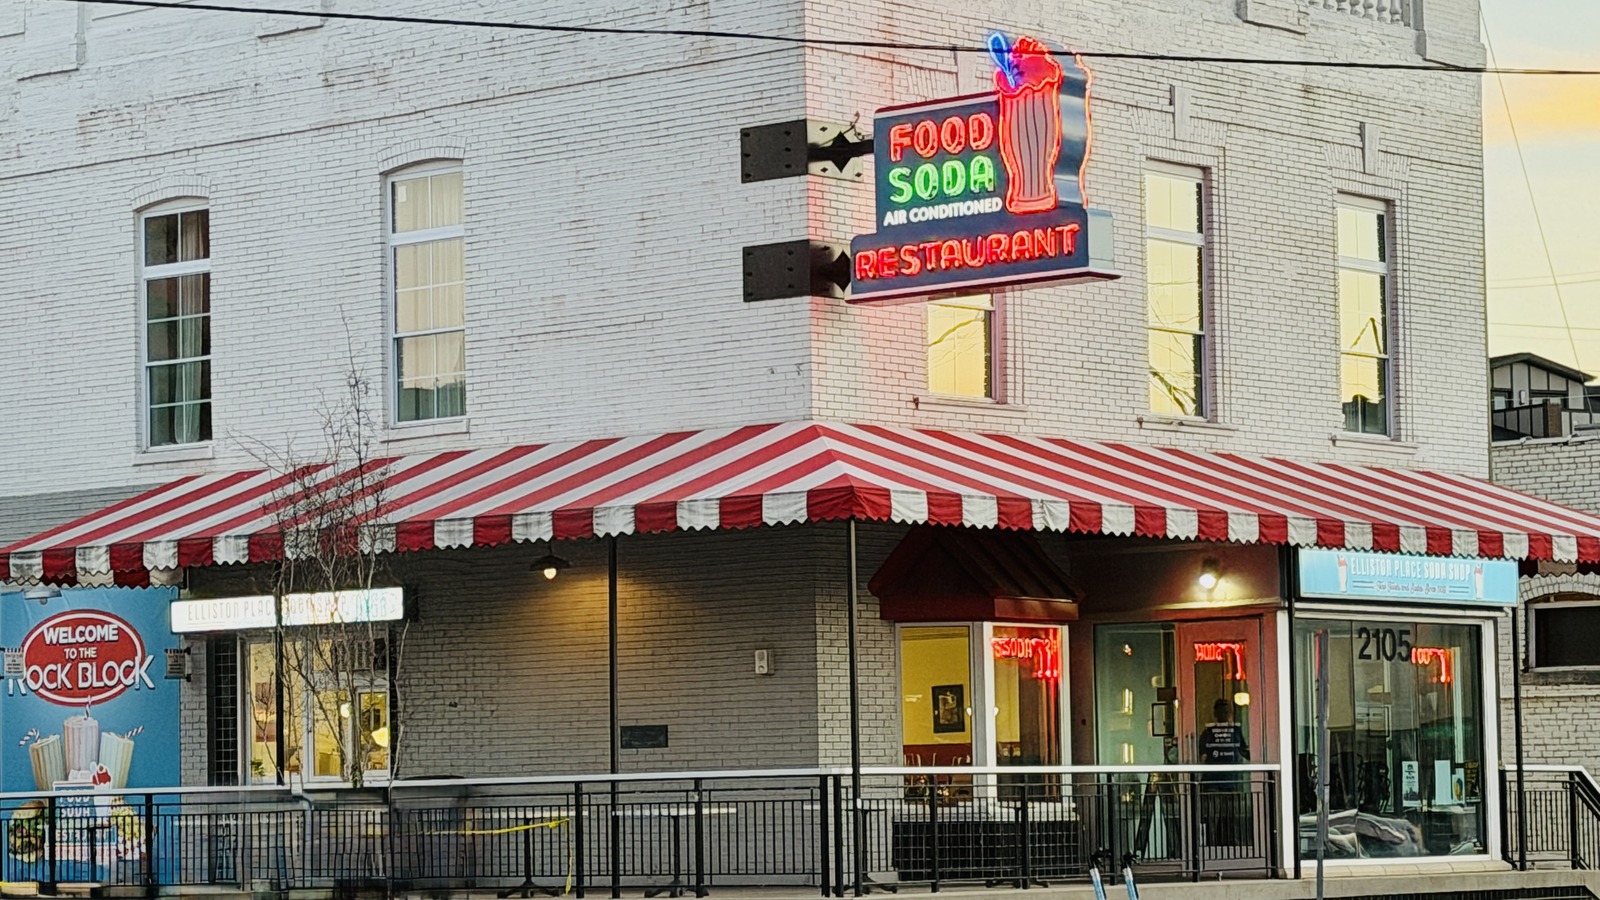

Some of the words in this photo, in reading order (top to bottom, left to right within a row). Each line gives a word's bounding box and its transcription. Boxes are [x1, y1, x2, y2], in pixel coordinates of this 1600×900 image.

[889, 112, 995, 162] FOOD
[888, 154, 995, 204] SODA
[883, 210, 907, 227] AIR
[910, 197, 1003, 223] CONDITIONED
[855, 224, 1079, 280] RESTAURANT
[1351, 557, 1393, 578] ELLISTON
[1394, 561, 1422, 579] PLACE
[1423, 563, 1447, 581] SODA
[1448, 563, 1471, 582] SHOP
[187, 601, 240, 621] ELLISTON
[244, 599, 273, 618] PLAC
[42, 624, 119, 645] WELCOME
[1358, 626, 1411, 663] 2105
[64, 647, 77, 660] TO
[79, 647, 97, 659] THE
[78, 655, 155, 689] BLOCK
